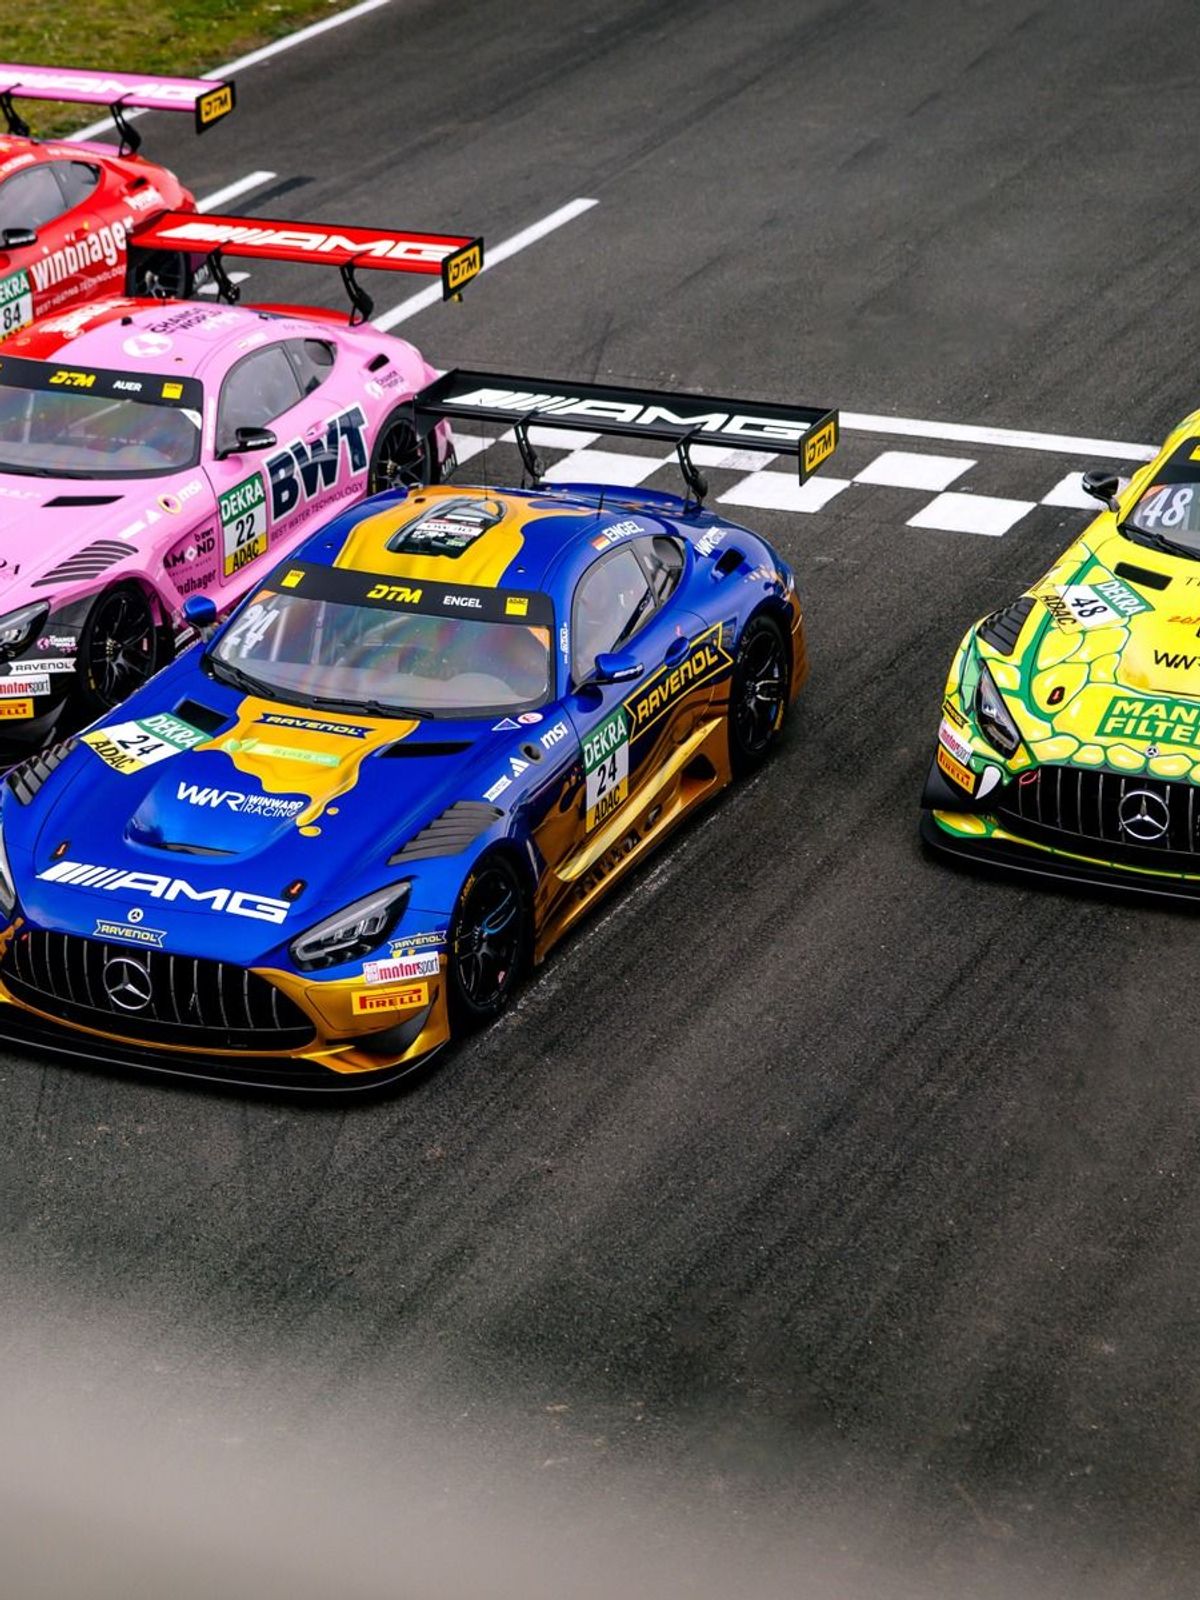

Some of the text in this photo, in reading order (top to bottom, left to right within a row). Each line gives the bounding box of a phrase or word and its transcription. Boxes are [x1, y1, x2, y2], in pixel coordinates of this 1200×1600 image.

[204, 94, 229, 116] DTM
[450, 253, 478, 280] DTM
[0, 273, 30, 302] EKRA
[3, 302, 21, 330] 84
[49, 370, 97, 388] DTM
[113, 379, 143, 392] AUER
[807, 429, 835, 465] DTM
[262, 401, 369, 525] BWT
[221, 479, 265, 522] DEKRA
[1142, 487, 1194, 527] 48
[235, 512, 256, 548] 22
[605, 520, 645, 542] ENGEL
[232, 539, 260, 574] ADAC
[176, 569, 216, 596] ndhager
[366, 583, 423, 604] DTM
[442, 595, 483, 609] ENGEL
[1071, 596, 1108, 619] 48
[1098, 579, 1147, 616] DEKRA
[15, 662, 71, 672] RAVENOL
[1153, 649, 1200, 671] WN
[636, 645, 720, 725] RAVENOL
[264, 714, 360, 736] RAVENOL
[1112, 700, 1200, 727] MAN
[142, 714, 204, 748] DEKRA
[540, 721, 568, 750] msi
[583, 714, 627, 767] DEKRA
[1103, 717, 1200, 746] FILTE
[90, 739, 136, 770] ADAC
[115, 734, 158, 757] 24
[596, 752, 618, 799] 24
[940, 751, 971, 788] PIRELLI
[176, 781, 246, 811] WNR
[245, 801, 298, 818] RACING
[248, 794, 305, 811] WINWARD
[593, 783, 621, 825] ADAC
[104, 869, 291, 925] AMG
[100, 923, 158, 943] RAVENOL
[393, 934, 443, 950] RAVENOL
[379, 957, 439, 982] motorsport
[358, 987, 422, 1011] PIRELLI
